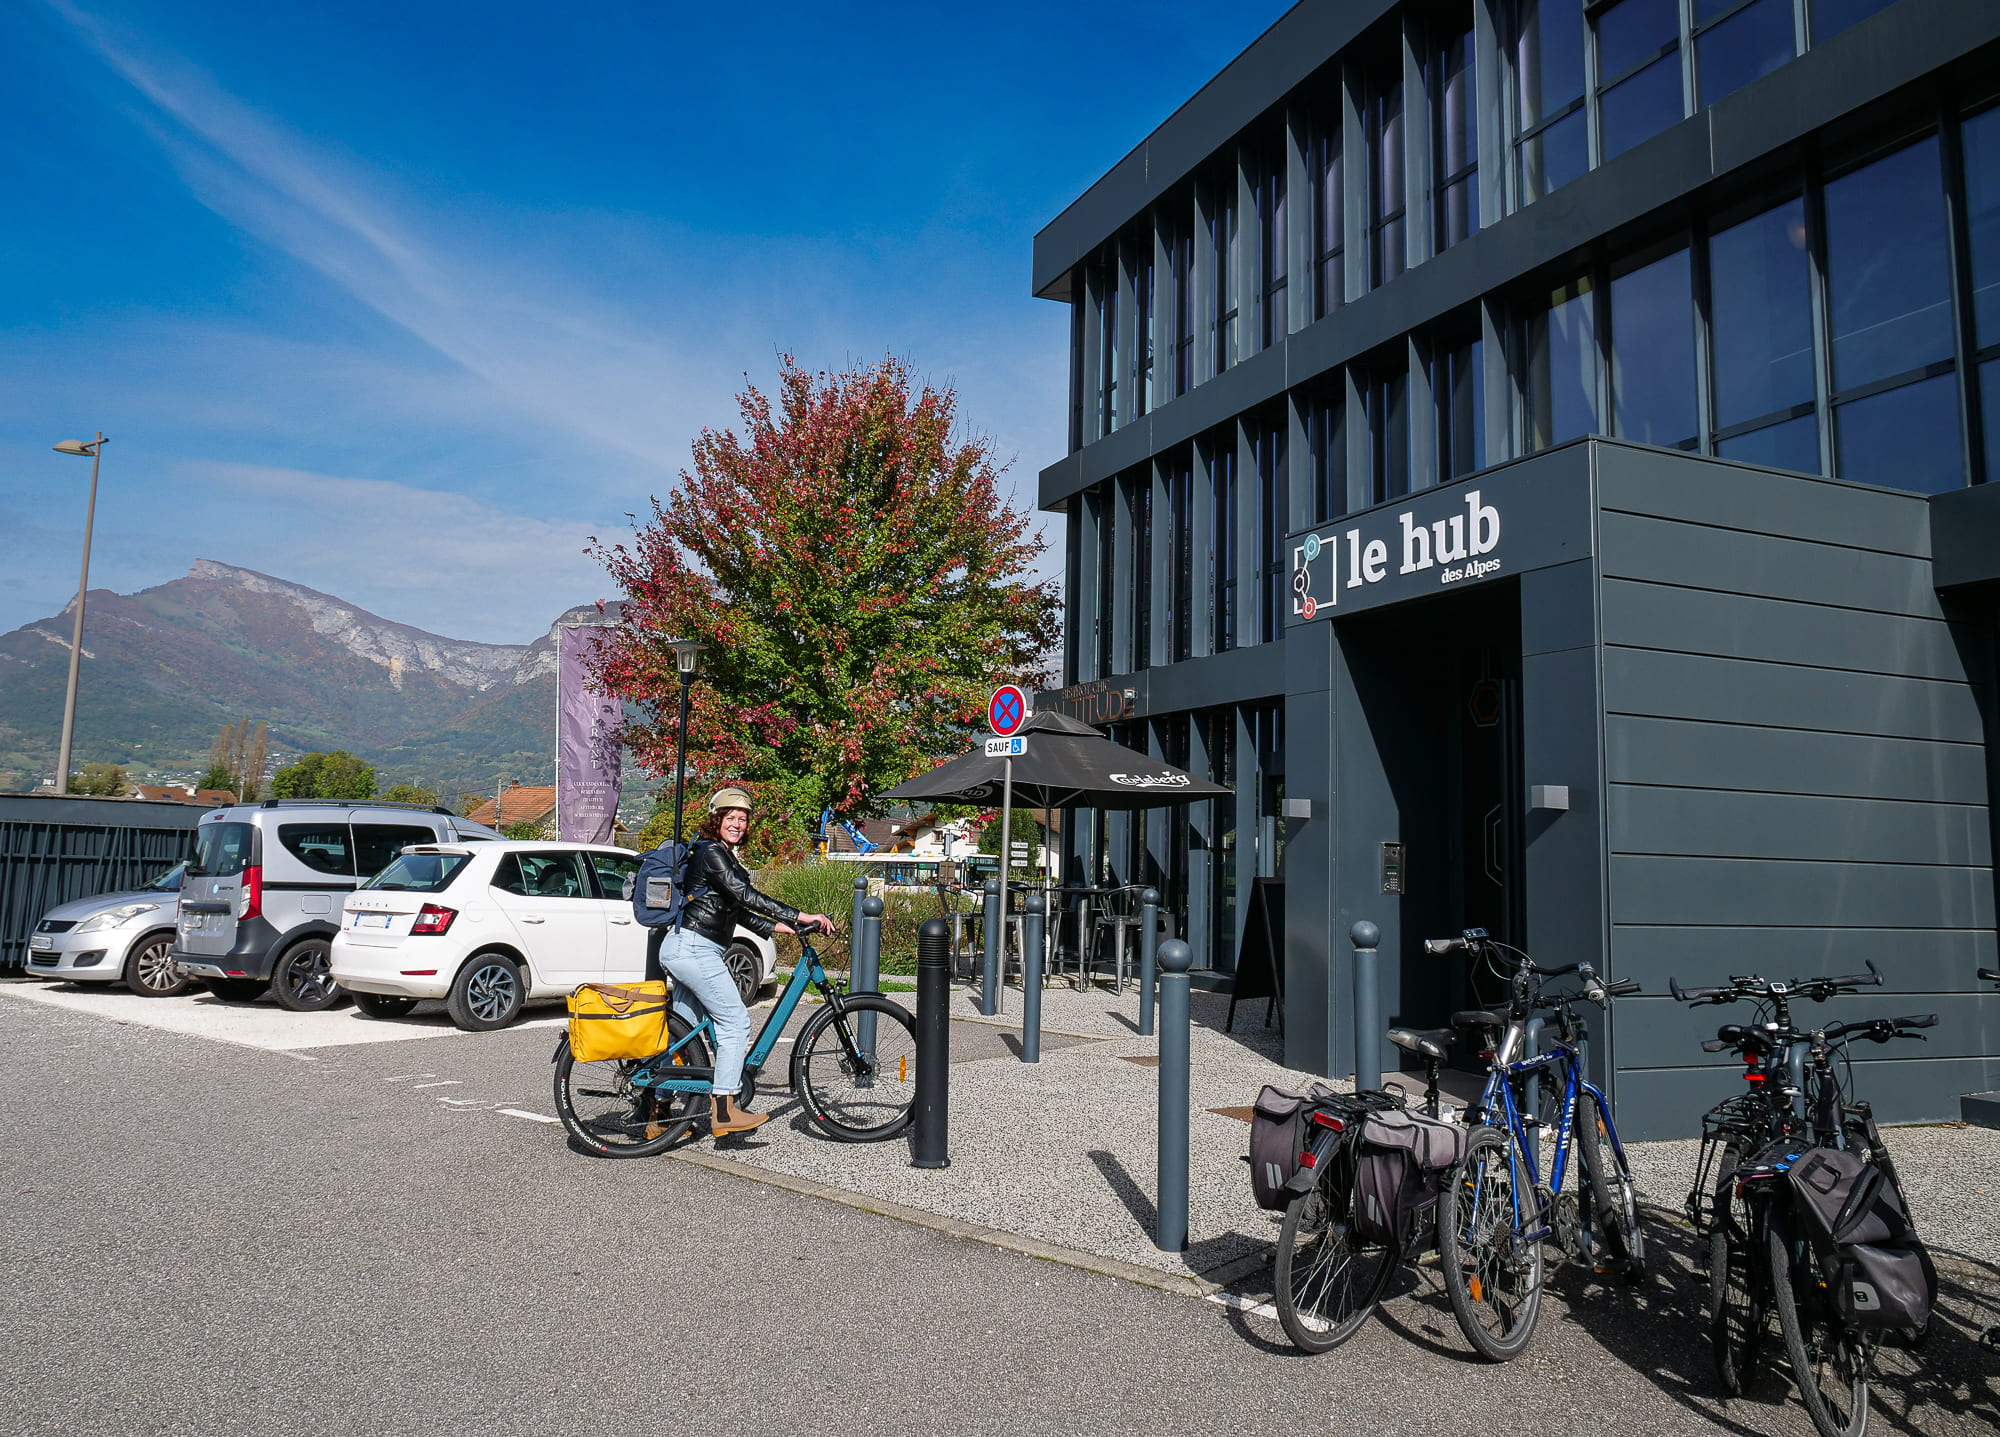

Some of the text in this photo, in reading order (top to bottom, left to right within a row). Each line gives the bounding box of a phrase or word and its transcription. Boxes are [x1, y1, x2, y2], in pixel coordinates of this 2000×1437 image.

[1346, 490, 1500, 589] le hub
[1441, 558, 1501, 584] des Alpes
[987, 741, 1009, 753] SAUF
[1109, 771, 1191, 788] Carlsberg
[568, 1117, 602, 1149] HUTCHINSON
